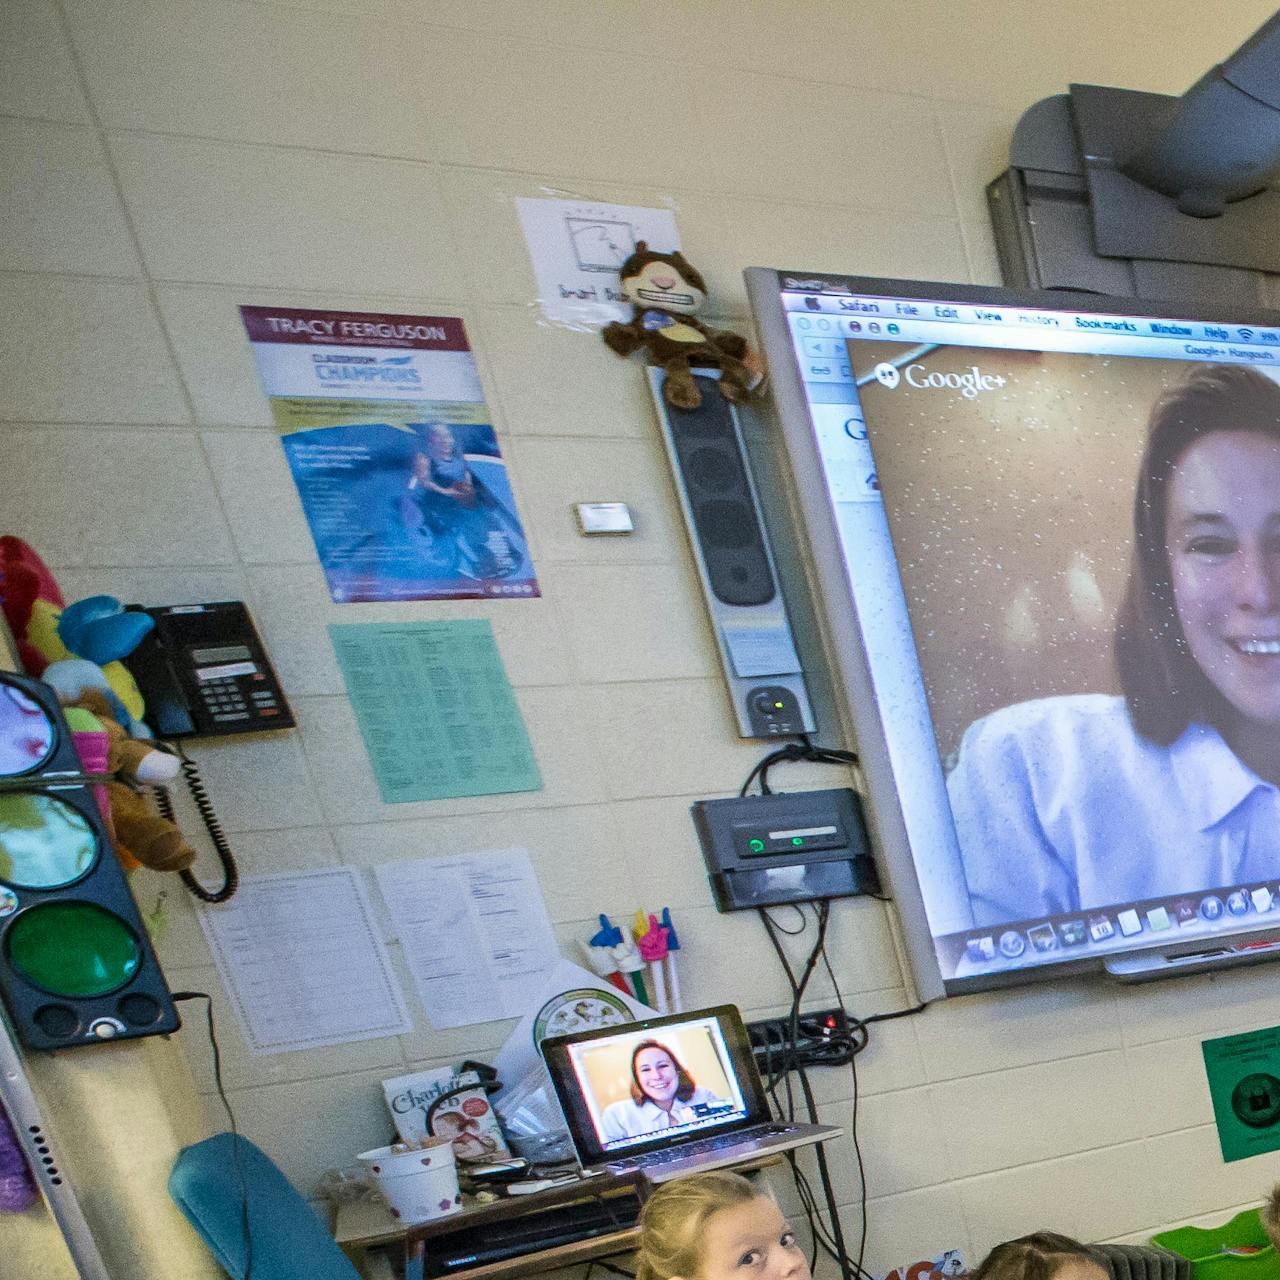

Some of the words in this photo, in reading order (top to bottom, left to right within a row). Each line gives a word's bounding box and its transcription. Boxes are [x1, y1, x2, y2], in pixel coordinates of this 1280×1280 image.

[264, 316, 334, 335] TRACY
[340, 321, 447, 341] FERGUSON
[839, 299, 880, 313] Safari
[896, 303, 919, 316] File
[935, 306, 959, 319] Edit
[975, 309, 1001, 321] View
[1075, 317, 1137, 332] Bookmarks
[1150, 323, 1192, 336] Window
[1204, 326, 1229, 340] Help
[905, 363, 1007, 398] Google+
